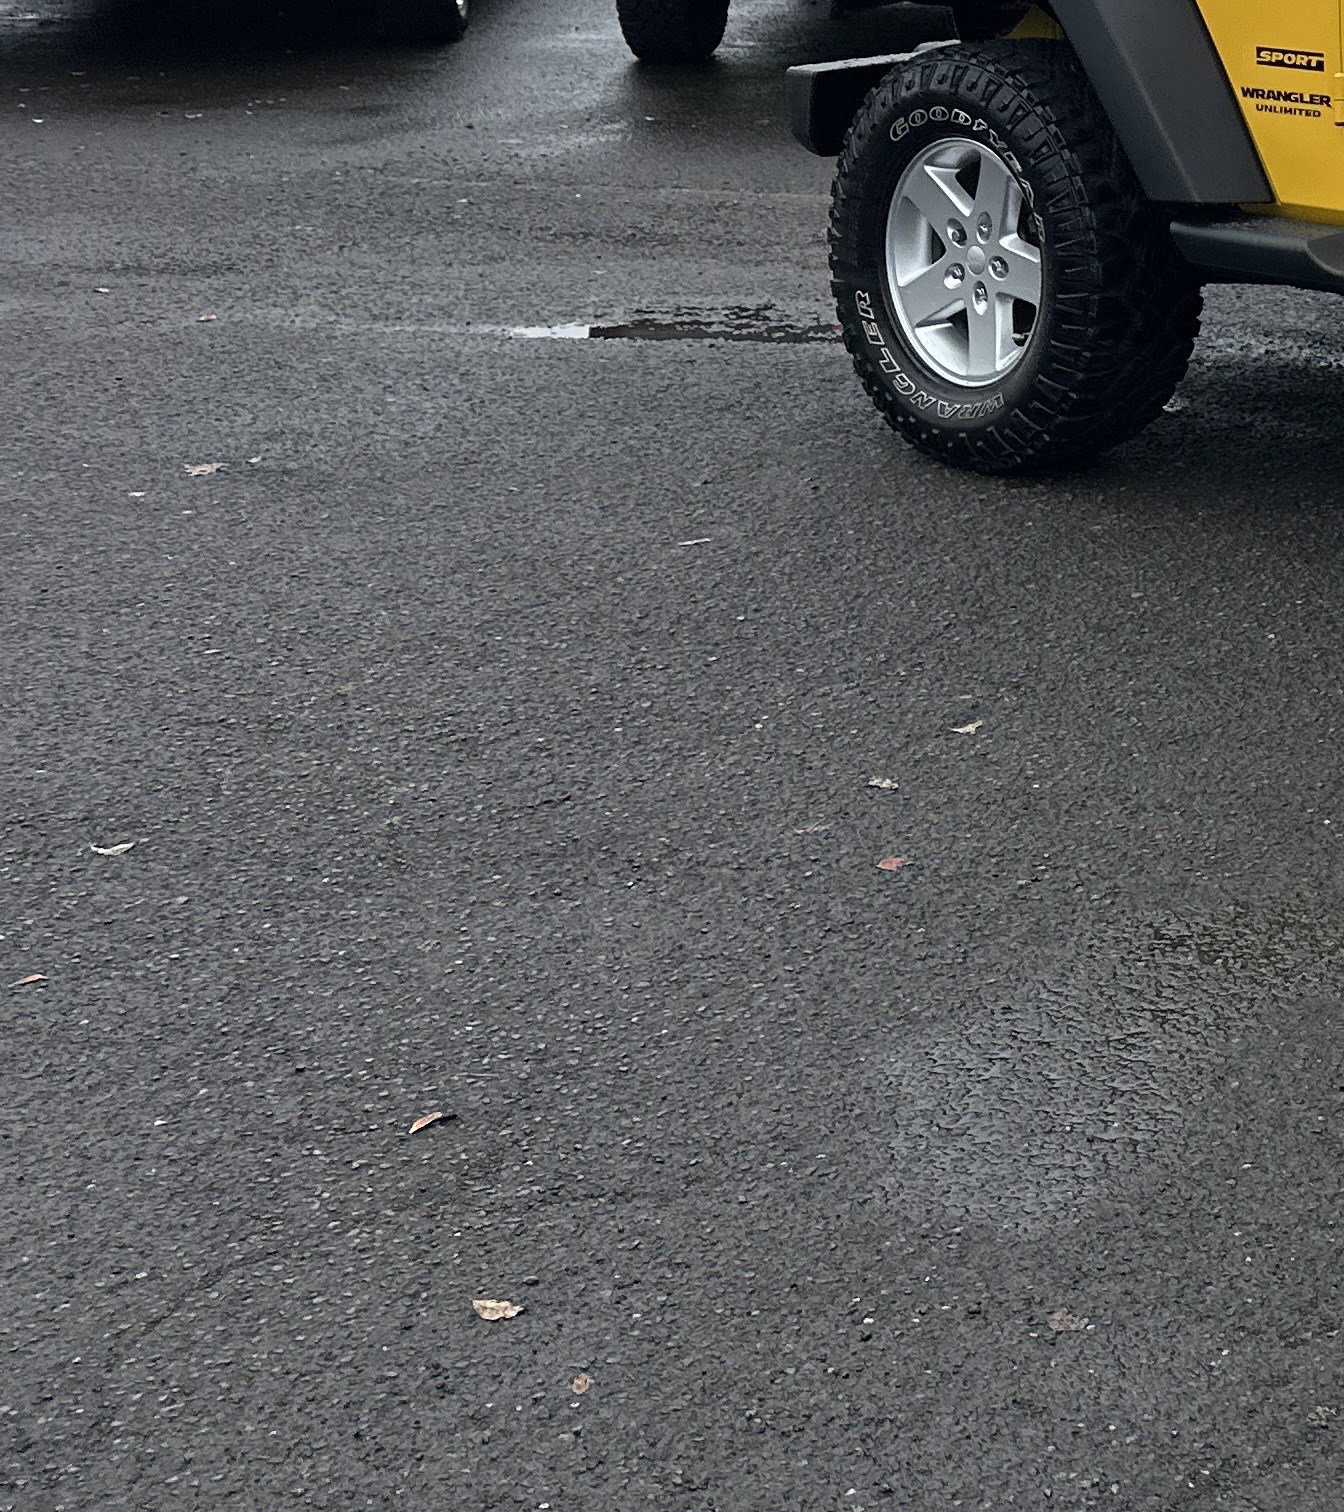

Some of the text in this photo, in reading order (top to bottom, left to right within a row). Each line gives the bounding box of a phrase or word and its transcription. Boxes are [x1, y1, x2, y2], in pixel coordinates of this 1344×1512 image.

[1257, 50, 1323, 67] SPORT
[1240, 87, 1334, 109] WRANGLER
[1256, 104, 1322, 118] UNLIMITED
[890, 106, 1046, 242] GOODYEAR
[855, 290, 1005, 419] WRANGLER
